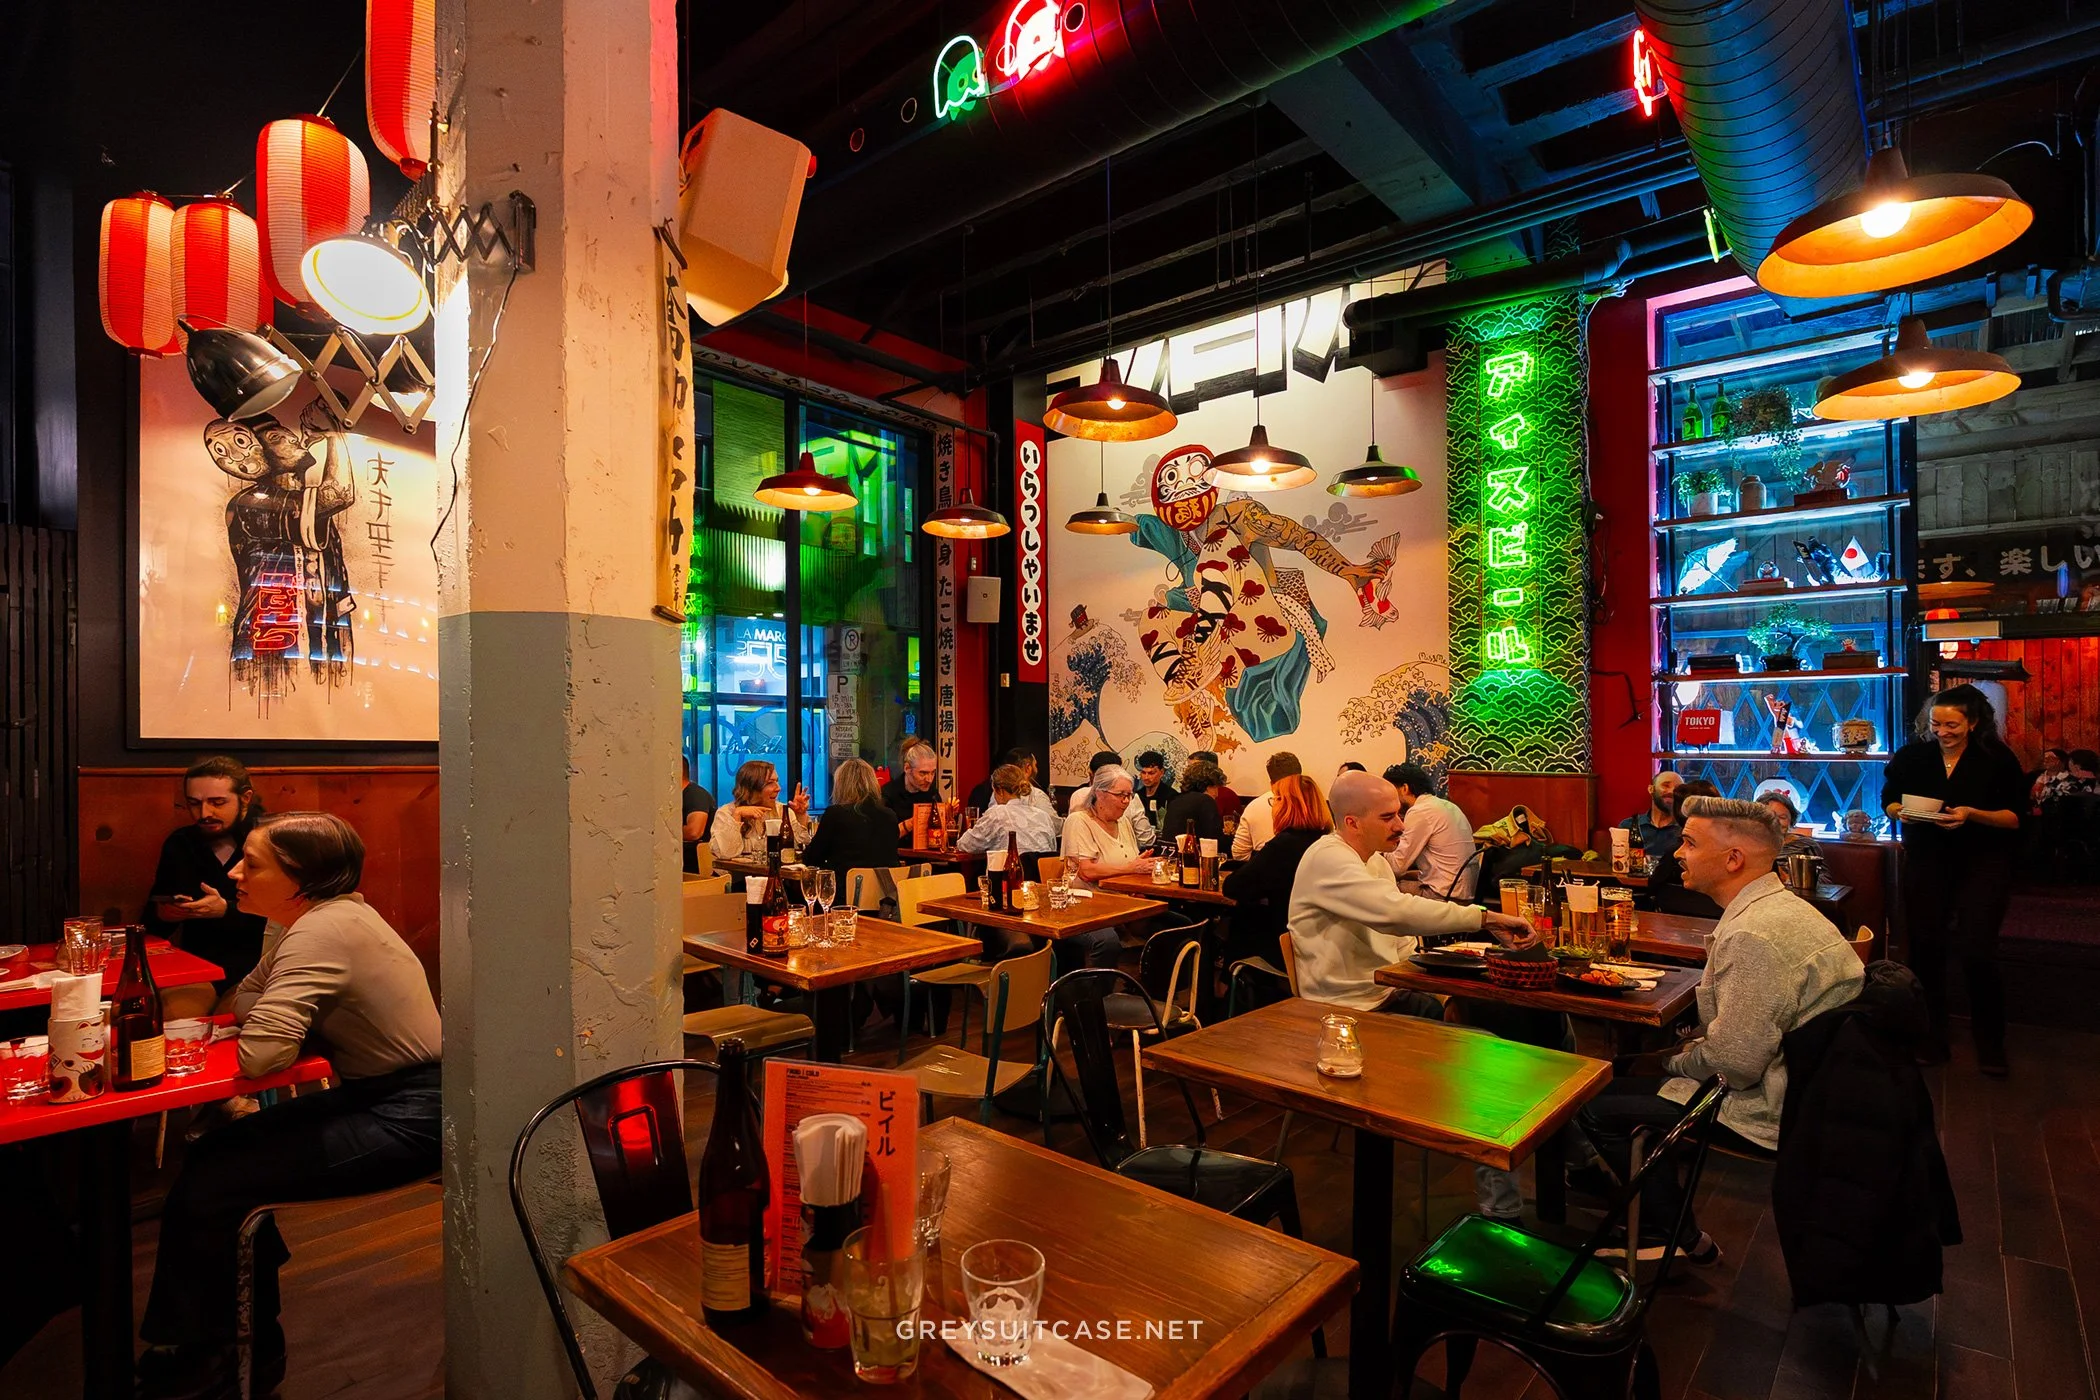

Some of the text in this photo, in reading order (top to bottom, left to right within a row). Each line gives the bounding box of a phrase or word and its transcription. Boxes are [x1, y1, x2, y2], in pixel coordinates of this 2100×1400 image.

[1485, 350, 1530, 665] アイスビール
[1685, 716, 1716, 726] TOKYO
[877, 1090, 896, 1157] ビイル
